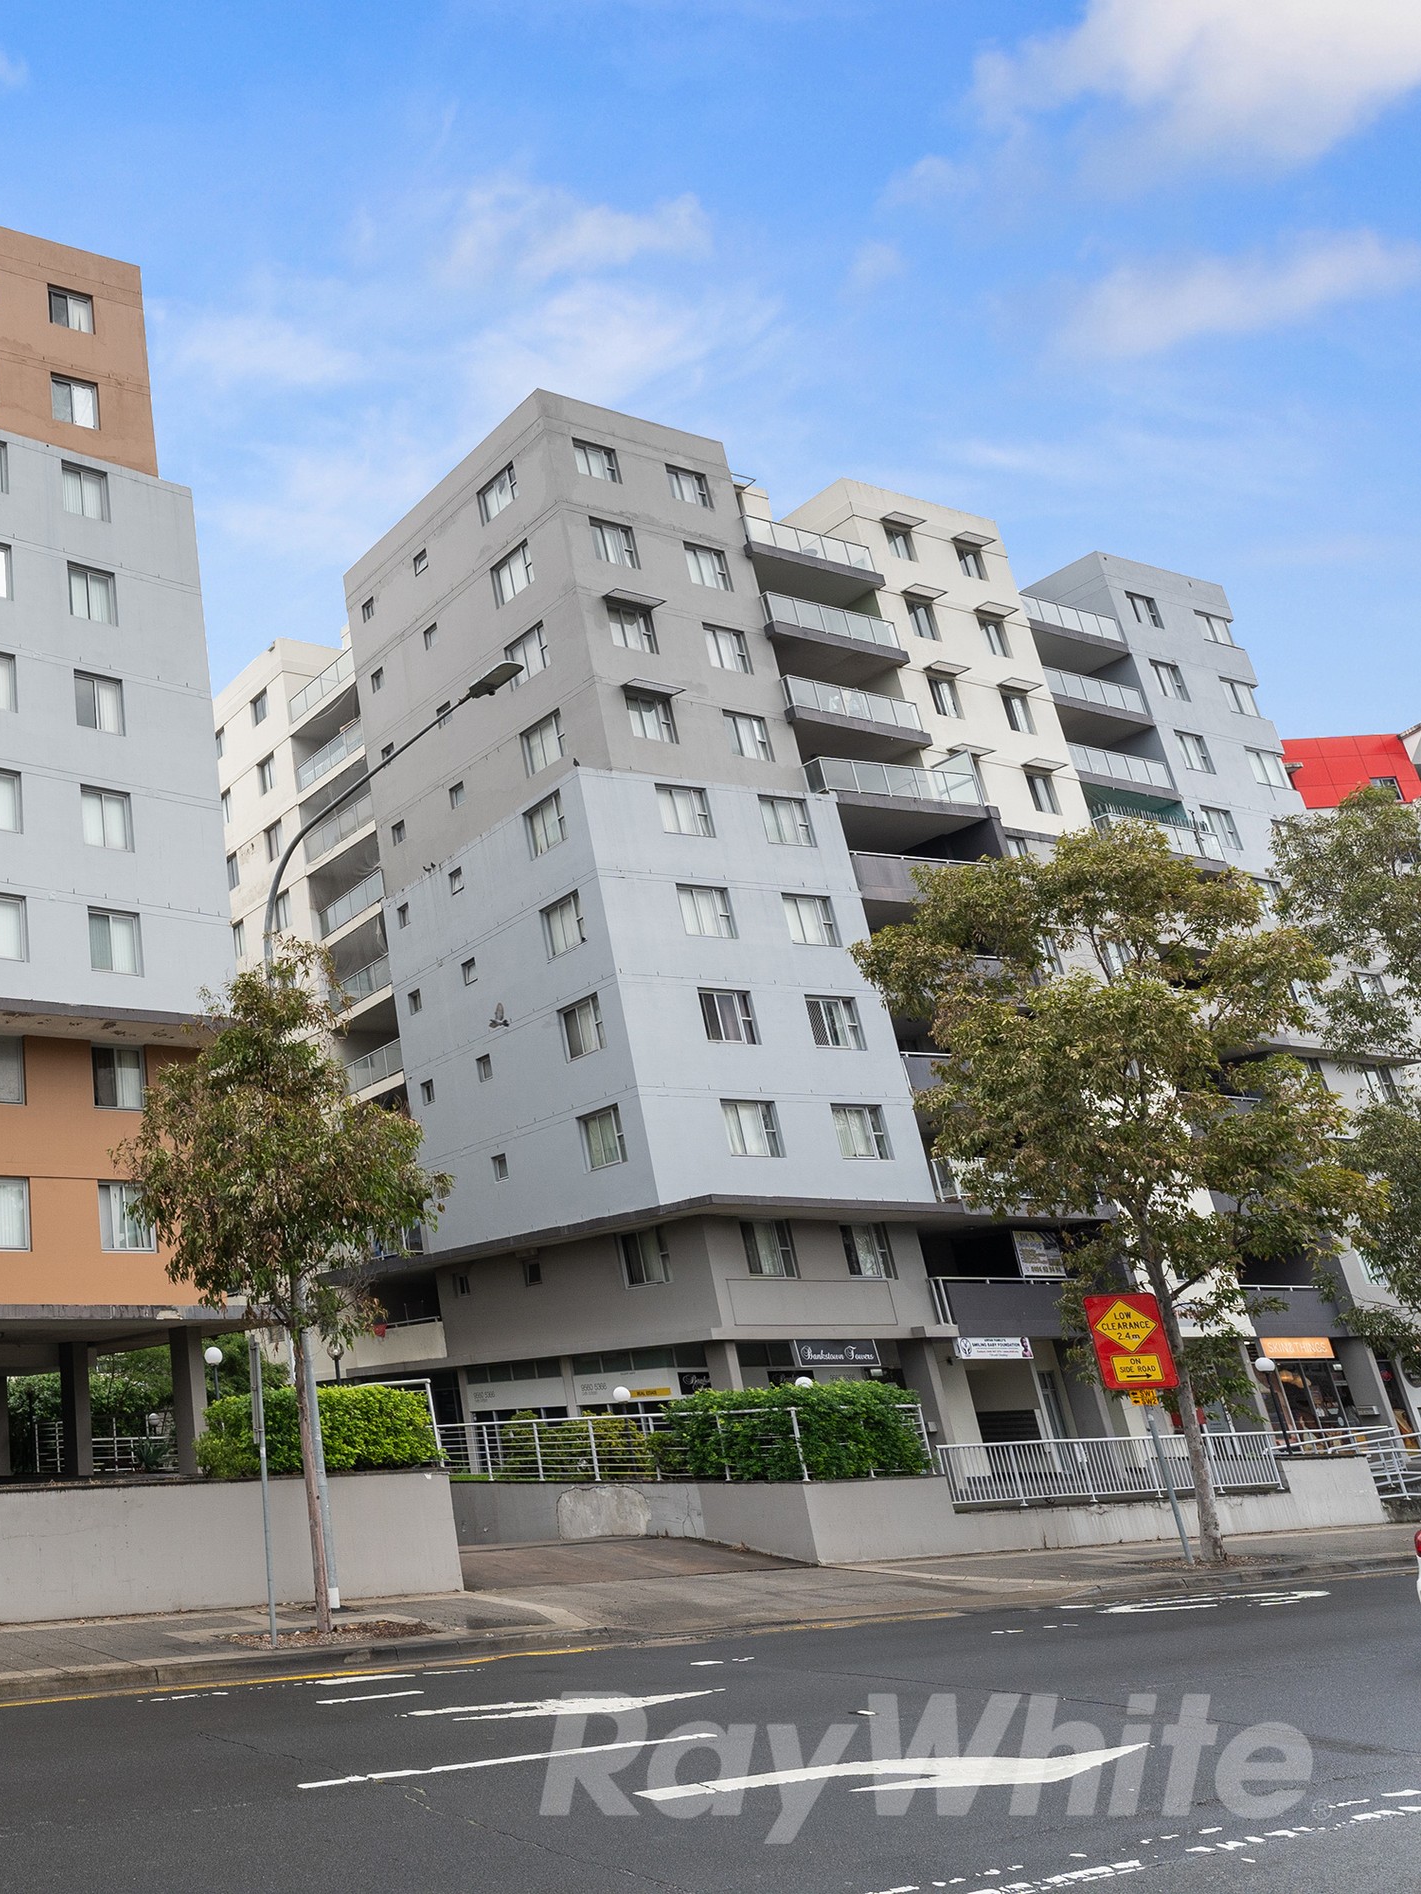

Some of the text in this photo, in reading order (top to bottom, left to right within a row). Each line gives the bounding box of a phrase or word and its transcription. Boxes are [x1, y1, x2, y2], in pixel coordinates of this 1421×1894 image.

[1113, 1311, 1132, 1320] LOW
[1101, 1320, 1151, 1331] CLEARANCE
[800, 1345, 875, 1361] Bankstown Towers
